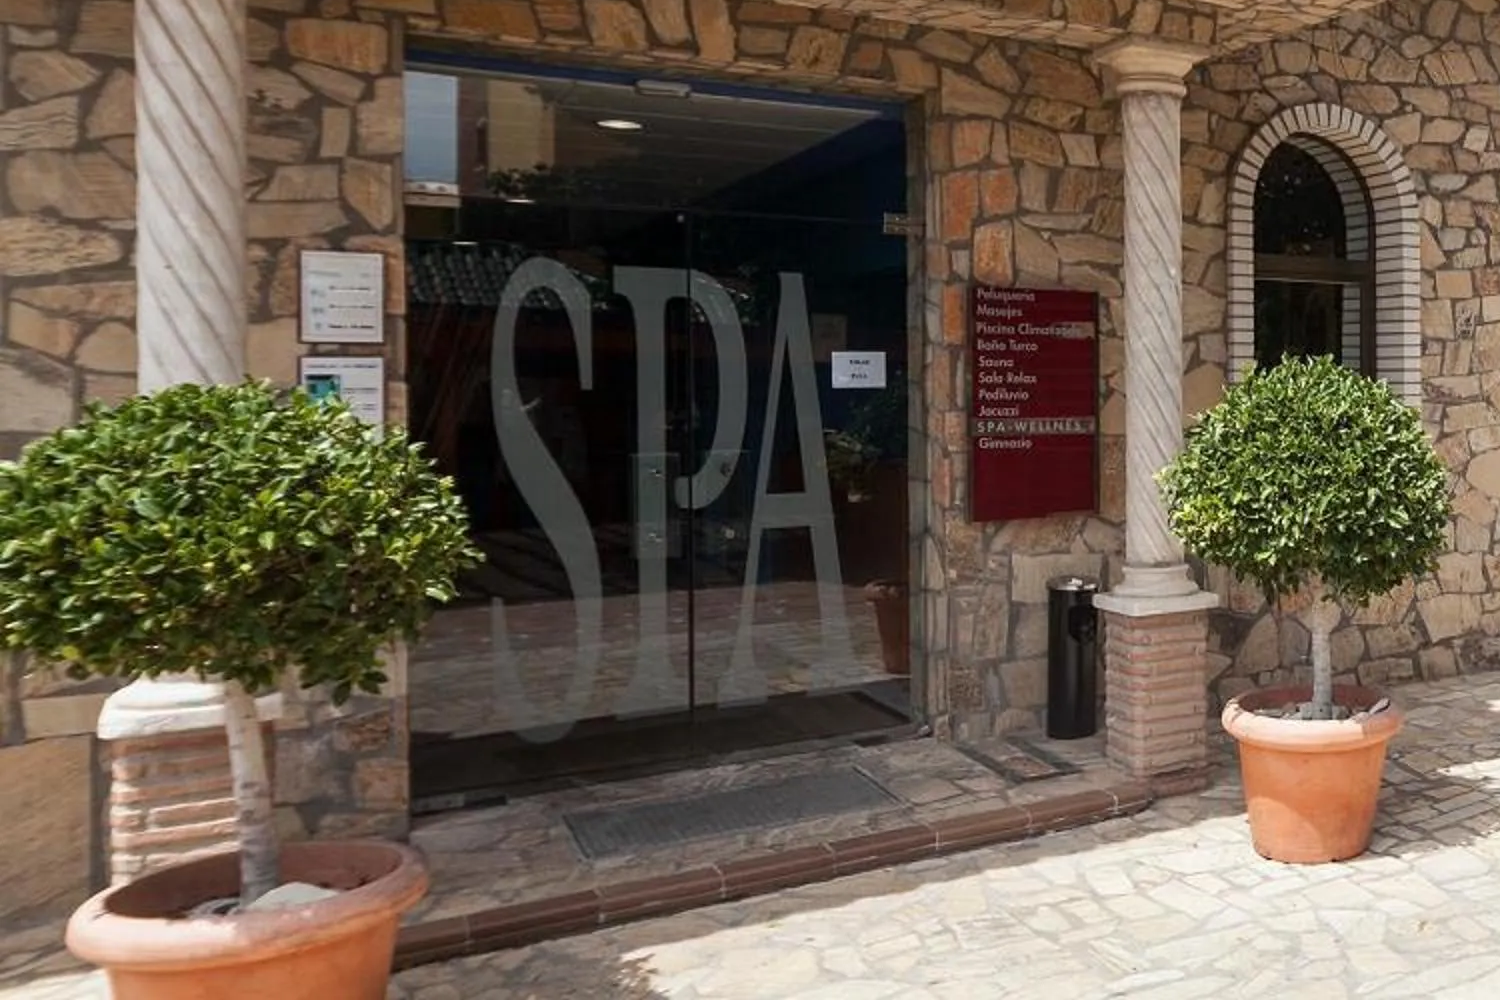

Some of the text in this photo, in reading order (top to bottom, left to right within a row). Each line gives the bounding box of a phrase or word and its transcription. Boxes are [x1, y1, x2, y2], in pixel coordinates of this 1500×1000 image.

[976, 304, 1023, 320] Masajes
[976, 321, 1015, 335] Piscina
[978, 356, 1014, 367] Sauna
[978, 372, 1038, 384] Sala Relax
[979, 405, 1019, 417] Jacuzzi
[979, 436, 1033, 449] Gimnasio
[491, 257, 854, 743] SPA
